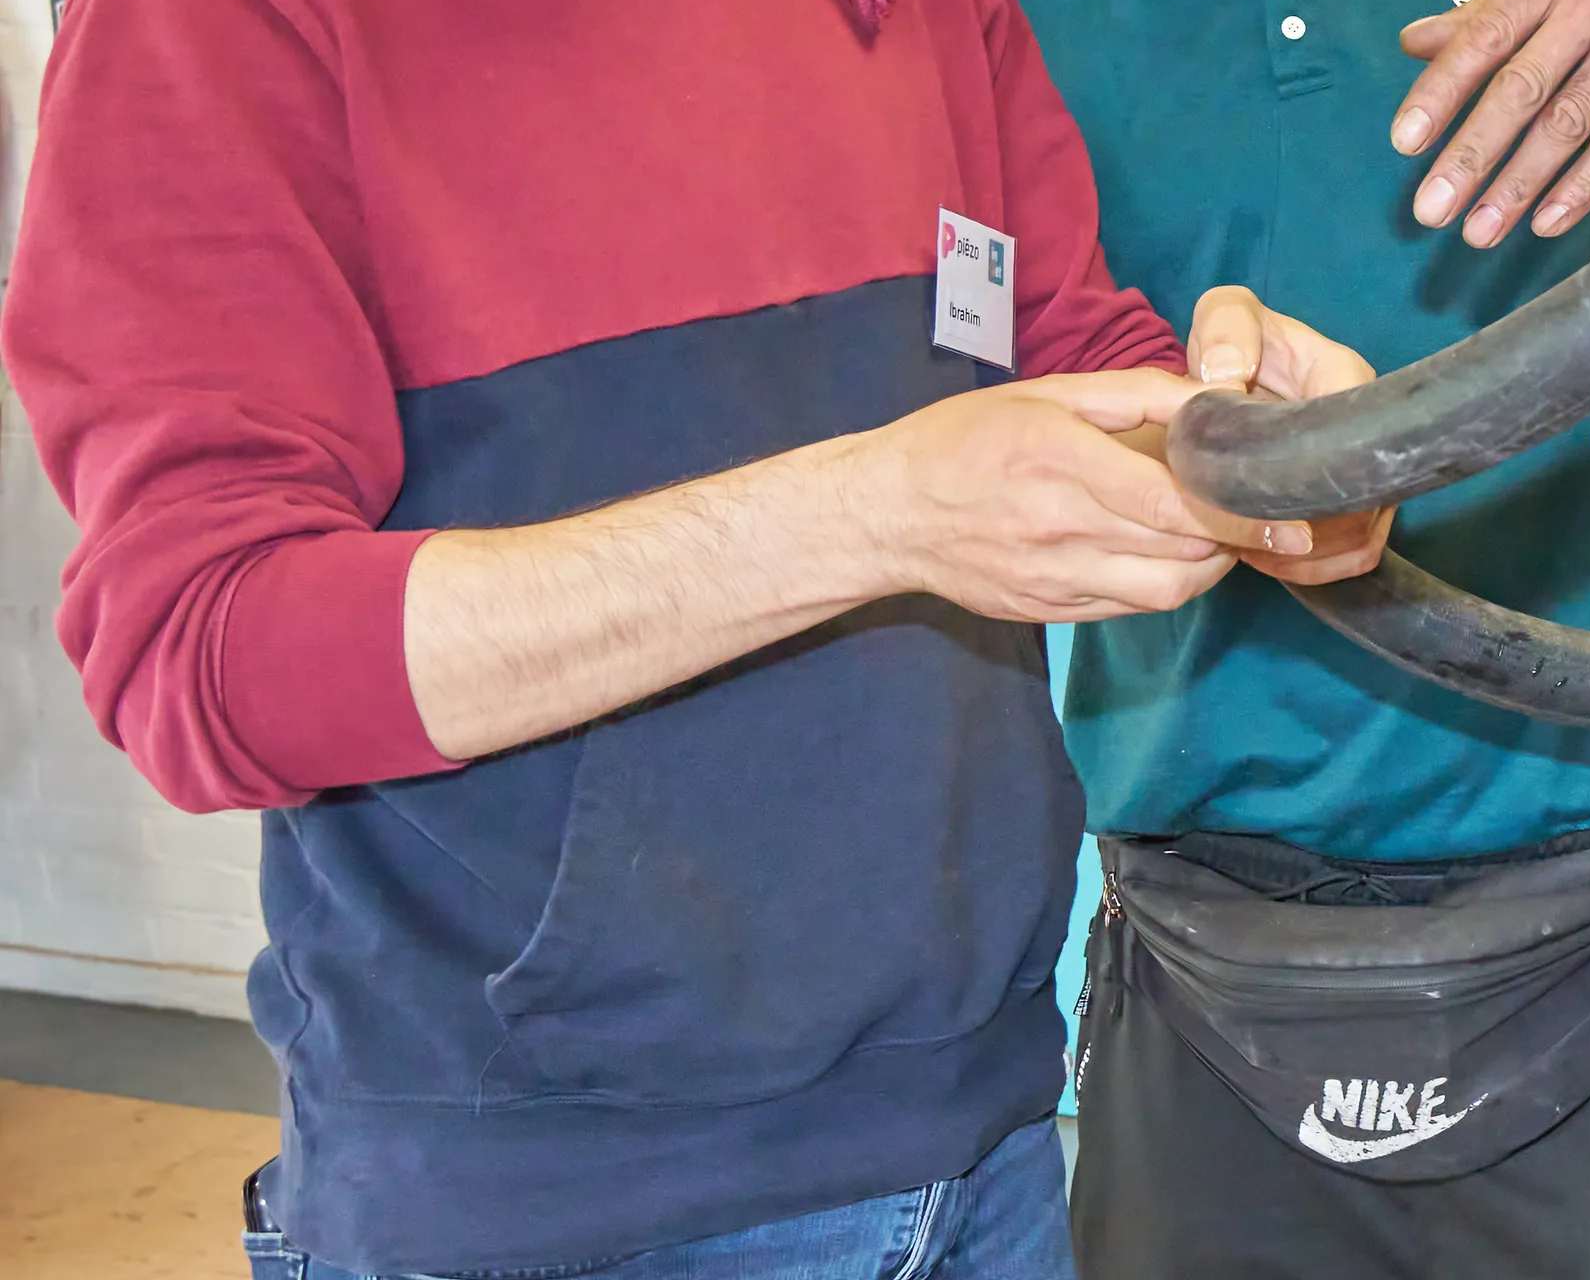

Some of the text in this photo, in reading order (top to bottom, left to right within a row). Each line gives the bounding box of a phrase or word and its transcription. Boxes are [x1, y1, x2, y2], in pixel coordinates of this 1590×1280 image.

[957, 237, 979, 260] piëzo
[949, 301, 981, 327] Ibrahim
[1321, 1076, 1448, 1132] NIKE
